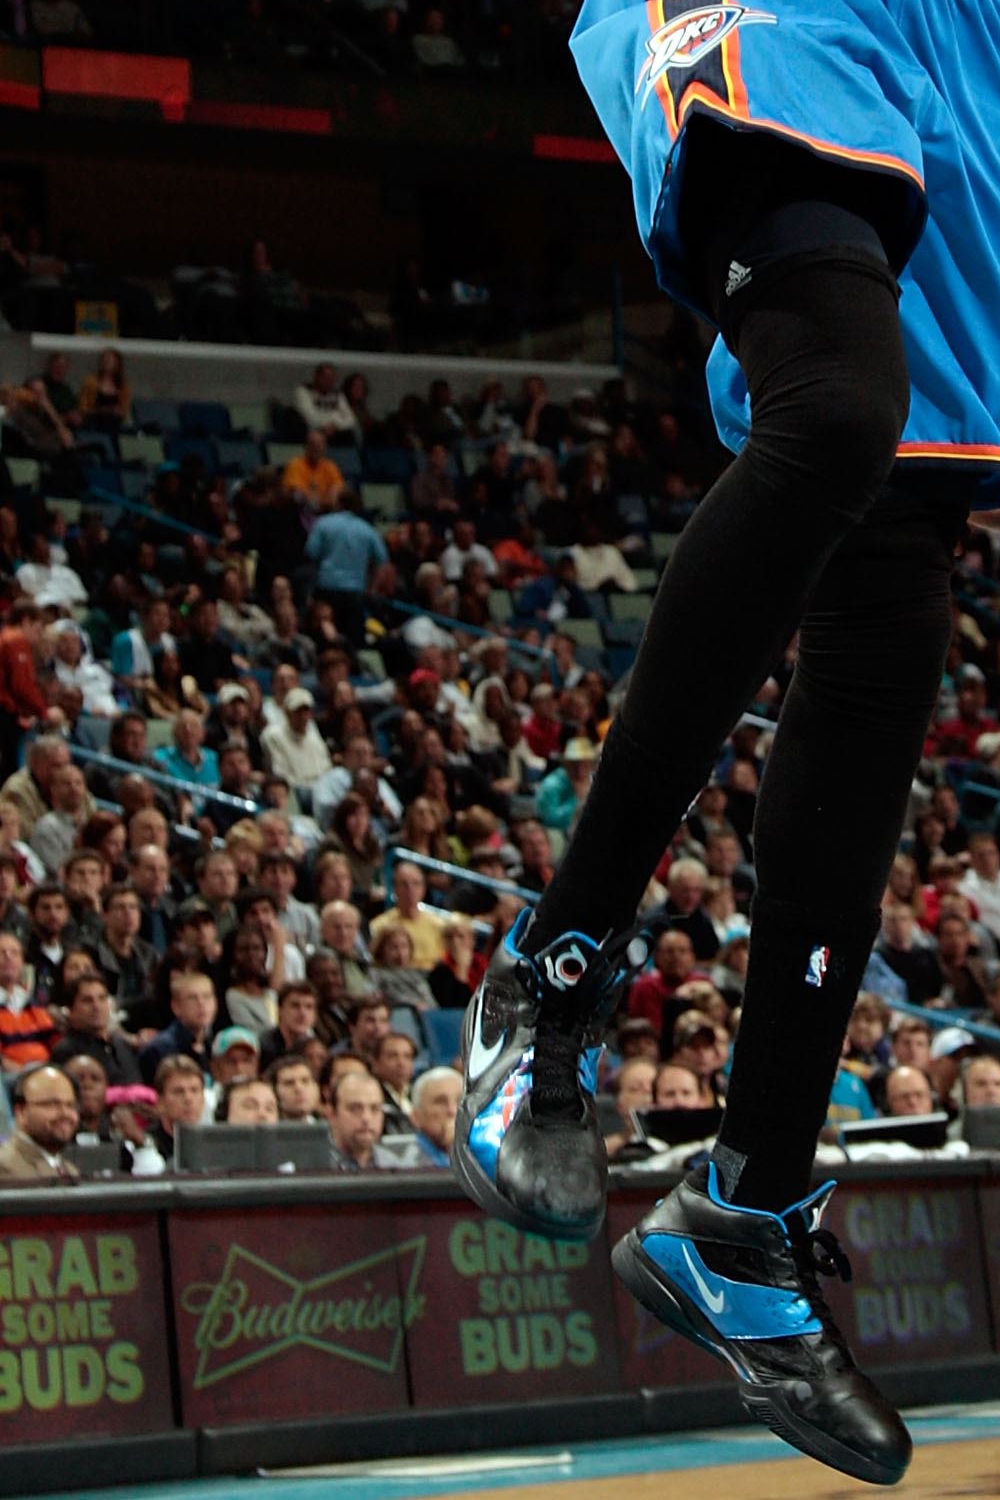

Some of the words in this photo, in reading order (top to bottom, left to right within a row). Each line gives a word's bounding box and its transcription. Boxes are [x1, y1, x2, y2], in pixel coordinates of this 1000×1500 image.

[0, 1235, 138, 1299] RAB
[478, 1273, 572, 1314] SOME
[2, 1300, 115, 1344] SOME
[181, 1279, 427, 1349] Budweiser
[460, 1311, 598, 1376] BUDS
[855, 1281, 972, 1344] BUDS
